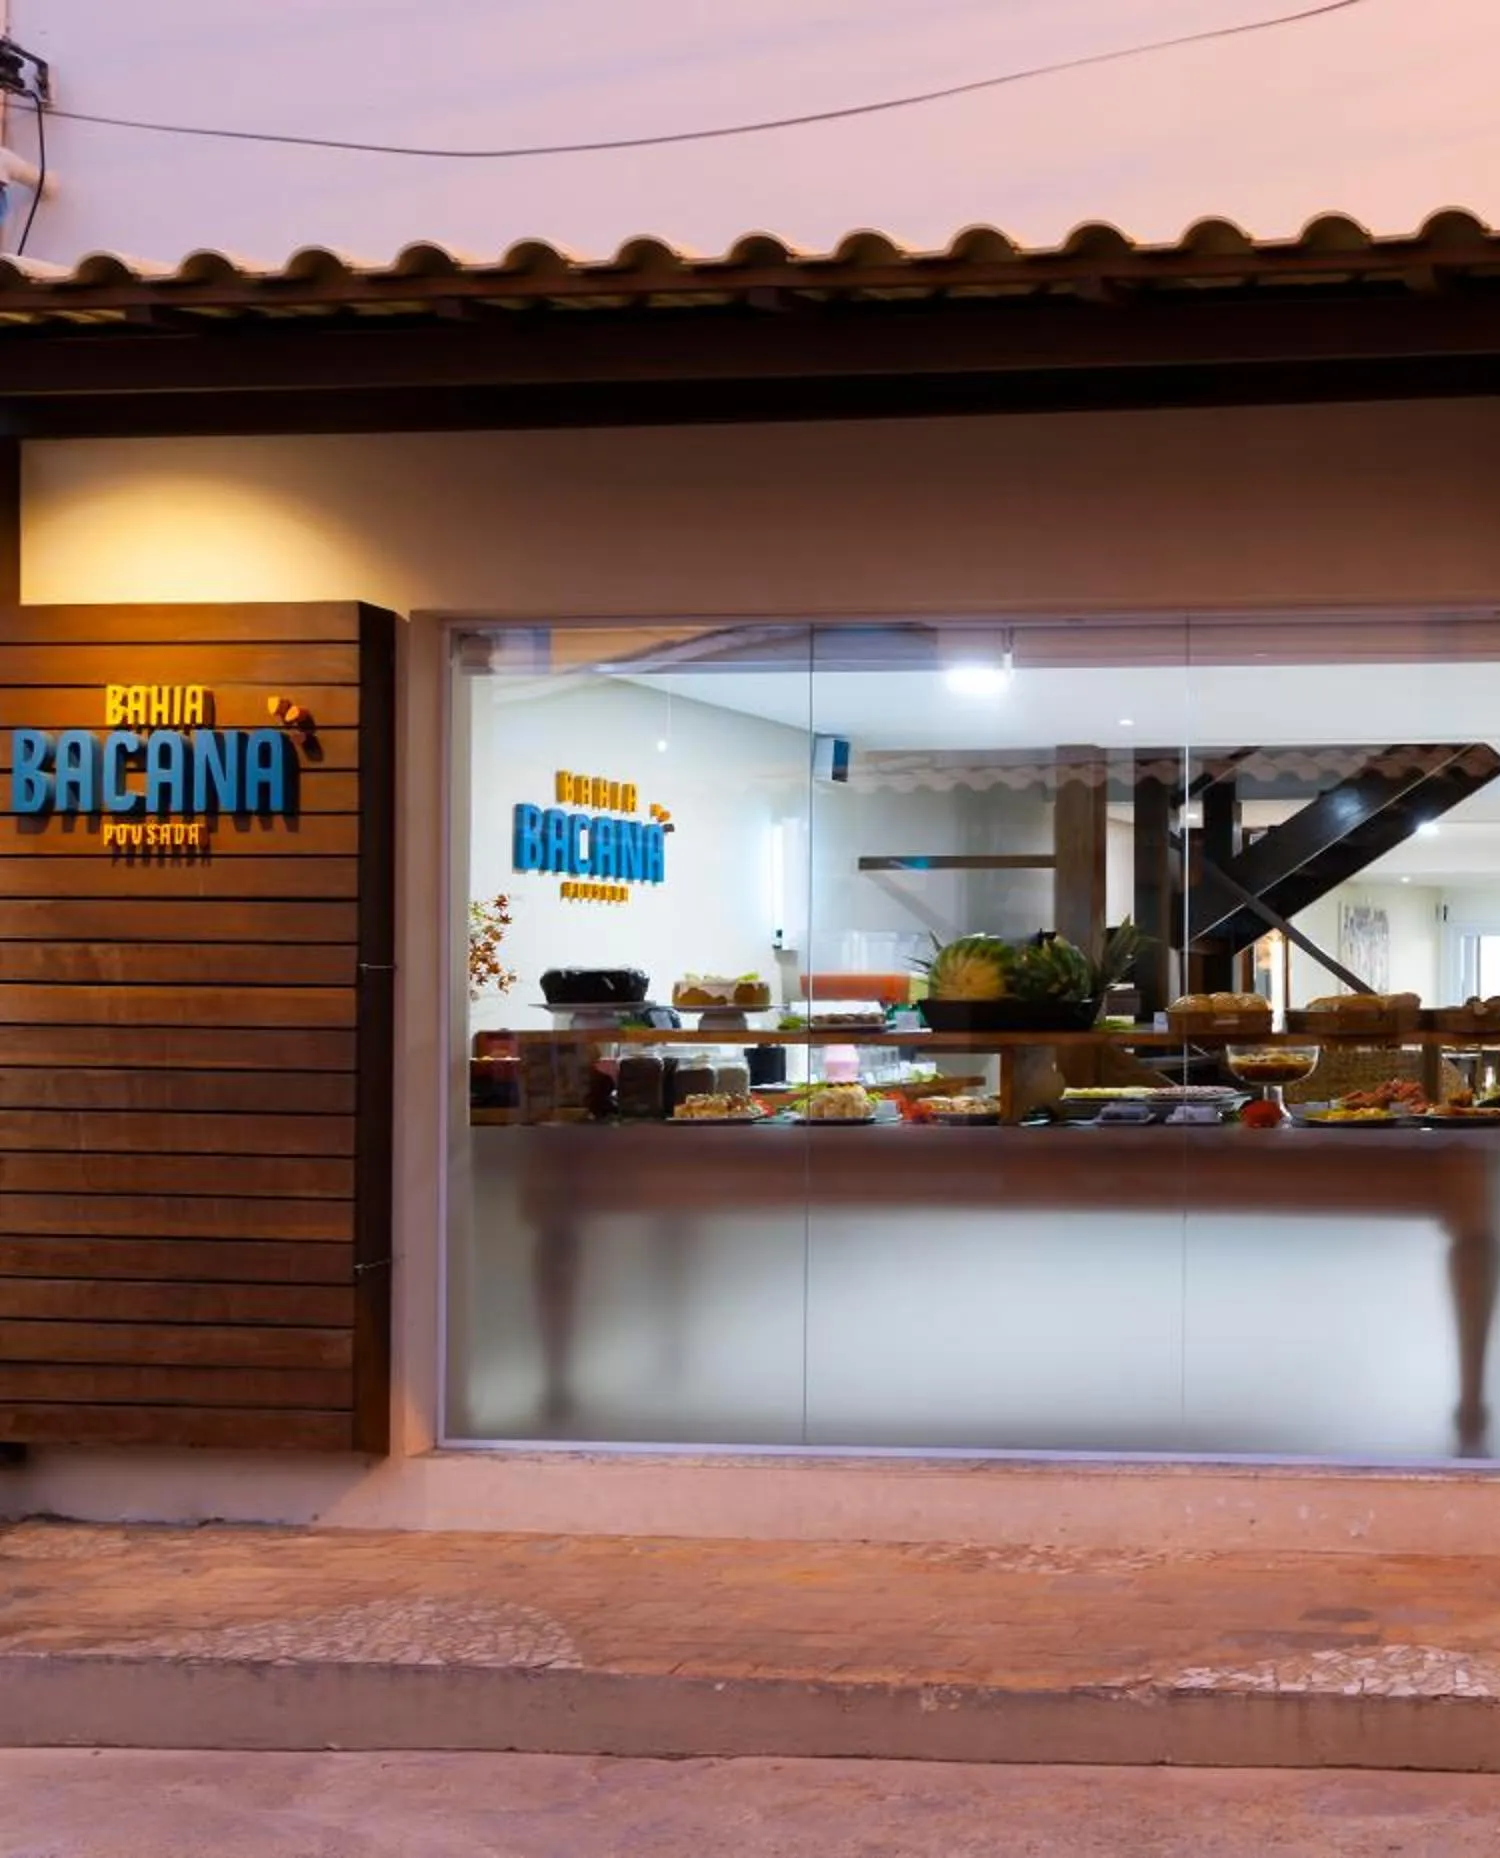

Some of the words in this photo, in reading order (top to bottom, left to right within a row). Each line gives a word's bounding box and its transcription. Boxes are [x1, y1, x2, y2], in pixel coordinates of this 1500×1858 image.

[105, 685, 204, 725] BAHIA
[10, 729, 284, 812] BACANA
[555, 769, 638, 813] BAHIA
[103, 823, 200, 845] POUSADA
[512, 803, 665, 883] BACANA
